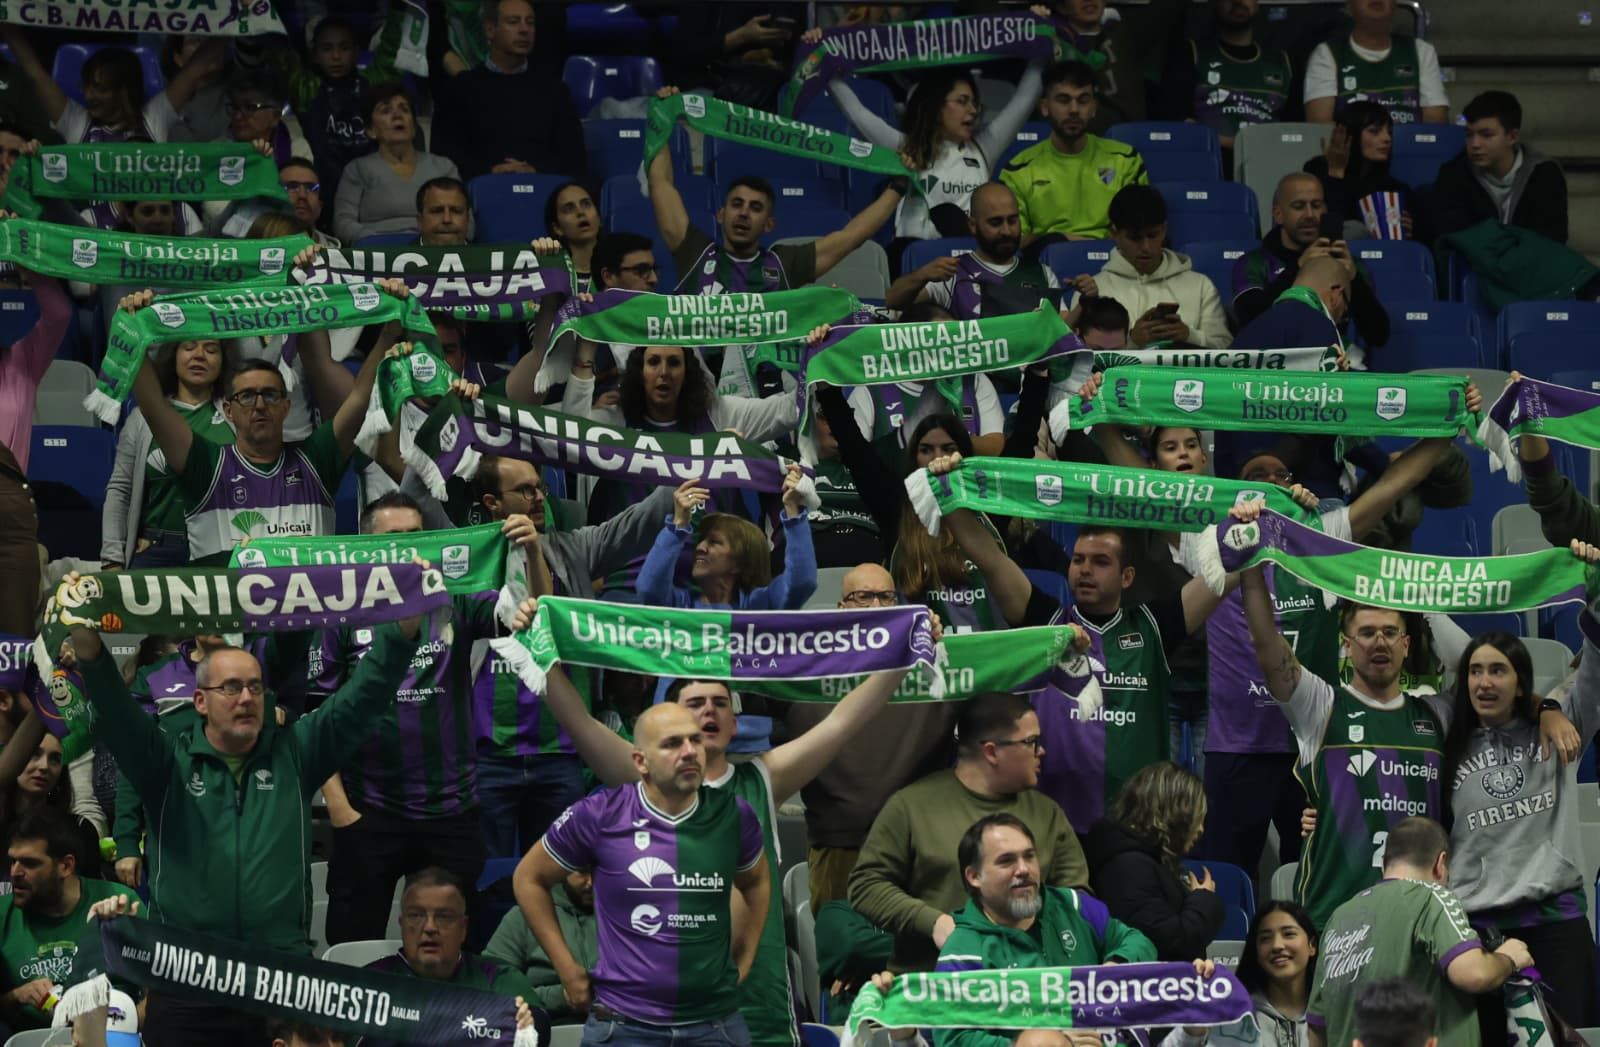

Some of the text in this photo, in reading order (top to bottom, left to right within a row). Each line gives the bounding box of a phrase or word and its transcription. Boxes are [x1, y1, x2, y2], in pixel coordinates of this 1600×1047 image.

[915, 17, 1036, 61] BALONCESTO
[94, 148, 201, 179] Unicaja
[122, 239, 239, 268] Unicaja
[119, 256, 243, 283] histórico
[200, 283, 328, 313] Unicaja
[667, 293, 764, 321] UNICAJA
[208, 305, 338, 333] histórico
[647, 310, 788, 342] BALONCESTO
[880, 319, 984, 353] UNICAJA
[861, 338, 1010, 380] BALONCESTO
[1244, 380, 1345, 410] Unicaja
[1242, 399, 1349, 424] histórico
[473, 398, 753, 490] UNICAJA
[1089, 474, 1215, 508] Unicaja
[1086, 494, 1217, 526] histórico
[267, 519, 313, 535] Unicaja
[1379, 555, 1489, 583] UNICAJA
[116, 566, 404, 616] UNICAJA
[1274, 595, 1315, 611] Unicaja
[1353, 574, 1512, 607] BALONCESTO
[179, 616, 348, 629] BALONCESTO
[569, 610, 890, 660] Unicaja Baloncesto
[683, 655, 779, 669] MALAGA
[1102, 672, 1149, 688] Unicaja
[1380, 759, 1439, 783] Unicaja
[1466, 791, 1554, 830] FIRENZE
[673, 872, 724, 889] Unicaja
[151, 941, 247, 998] UNICAJA
[253, 968, 392, 1027] BALONCESTO
[902, 970, 1233, 1013] Unicaja Baloncesto
